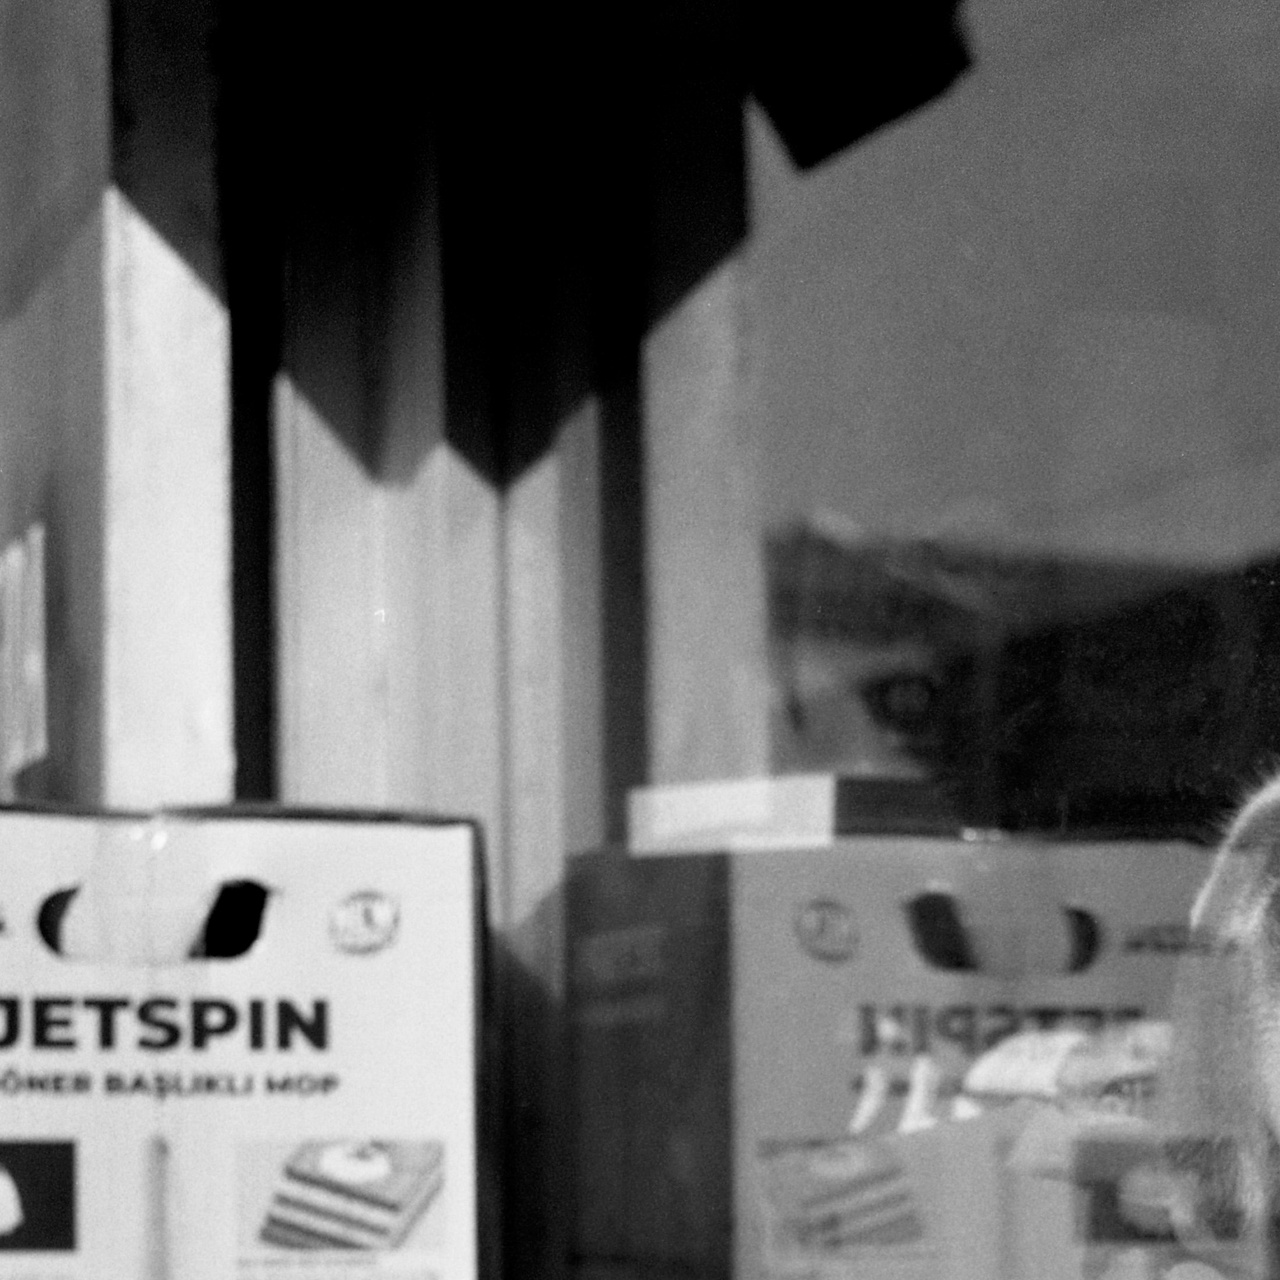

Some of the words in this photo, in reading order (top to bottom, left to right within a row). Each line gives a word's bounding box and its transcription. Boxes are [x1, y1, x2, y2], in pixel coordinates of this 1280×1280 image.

[0, 997, 328, 1050] JETSPIN
[0, 1068, 92, 1096] ÖNER
[265, 1072, 339, 1097] MOP
